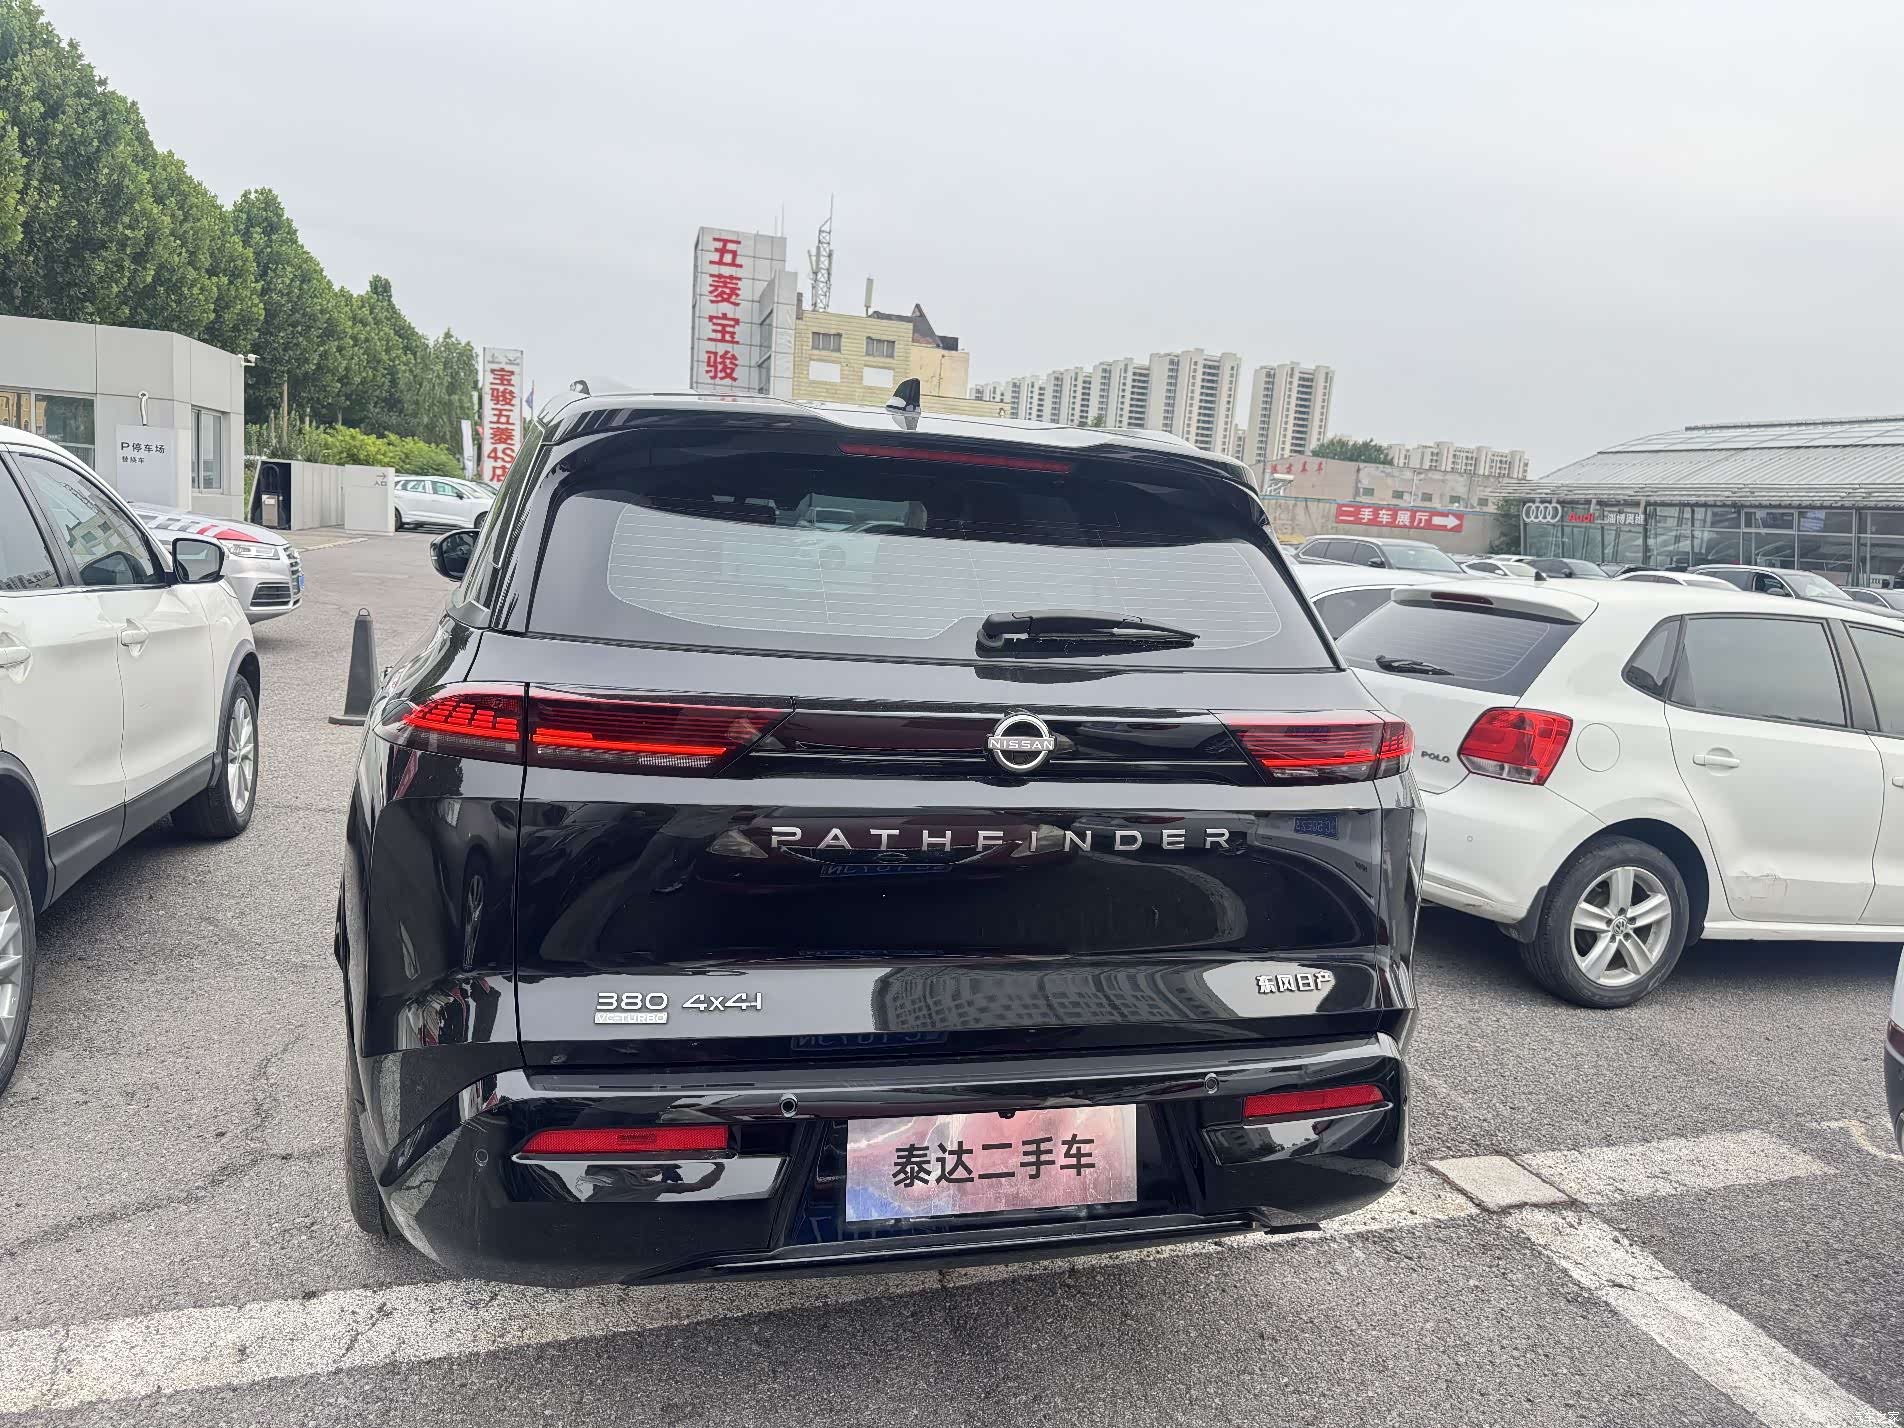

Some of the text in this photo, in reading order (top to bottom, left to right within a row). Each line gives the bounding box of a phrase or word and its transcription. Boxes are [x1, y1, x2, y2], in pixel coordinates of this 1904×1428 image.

[705, 237, 743, 383] 五菱宝骏
[486, 367, 517, 482] 宝骏五菱4S店
[1339, 506, 1430, 527] 二手车展厅
[1567, 511, 1596, 523] Audi
[989, 739, 1054, 750] NISSAN
[1421, 751, 1450, 763] POLO
[770, 826, 1231, 852] PATHFINDER
[1256, 971, 1332, 993] 东风日产
[596, 992, 668, 1010] 380
[891, 1133, 1096, 1188] 泰达二手车
